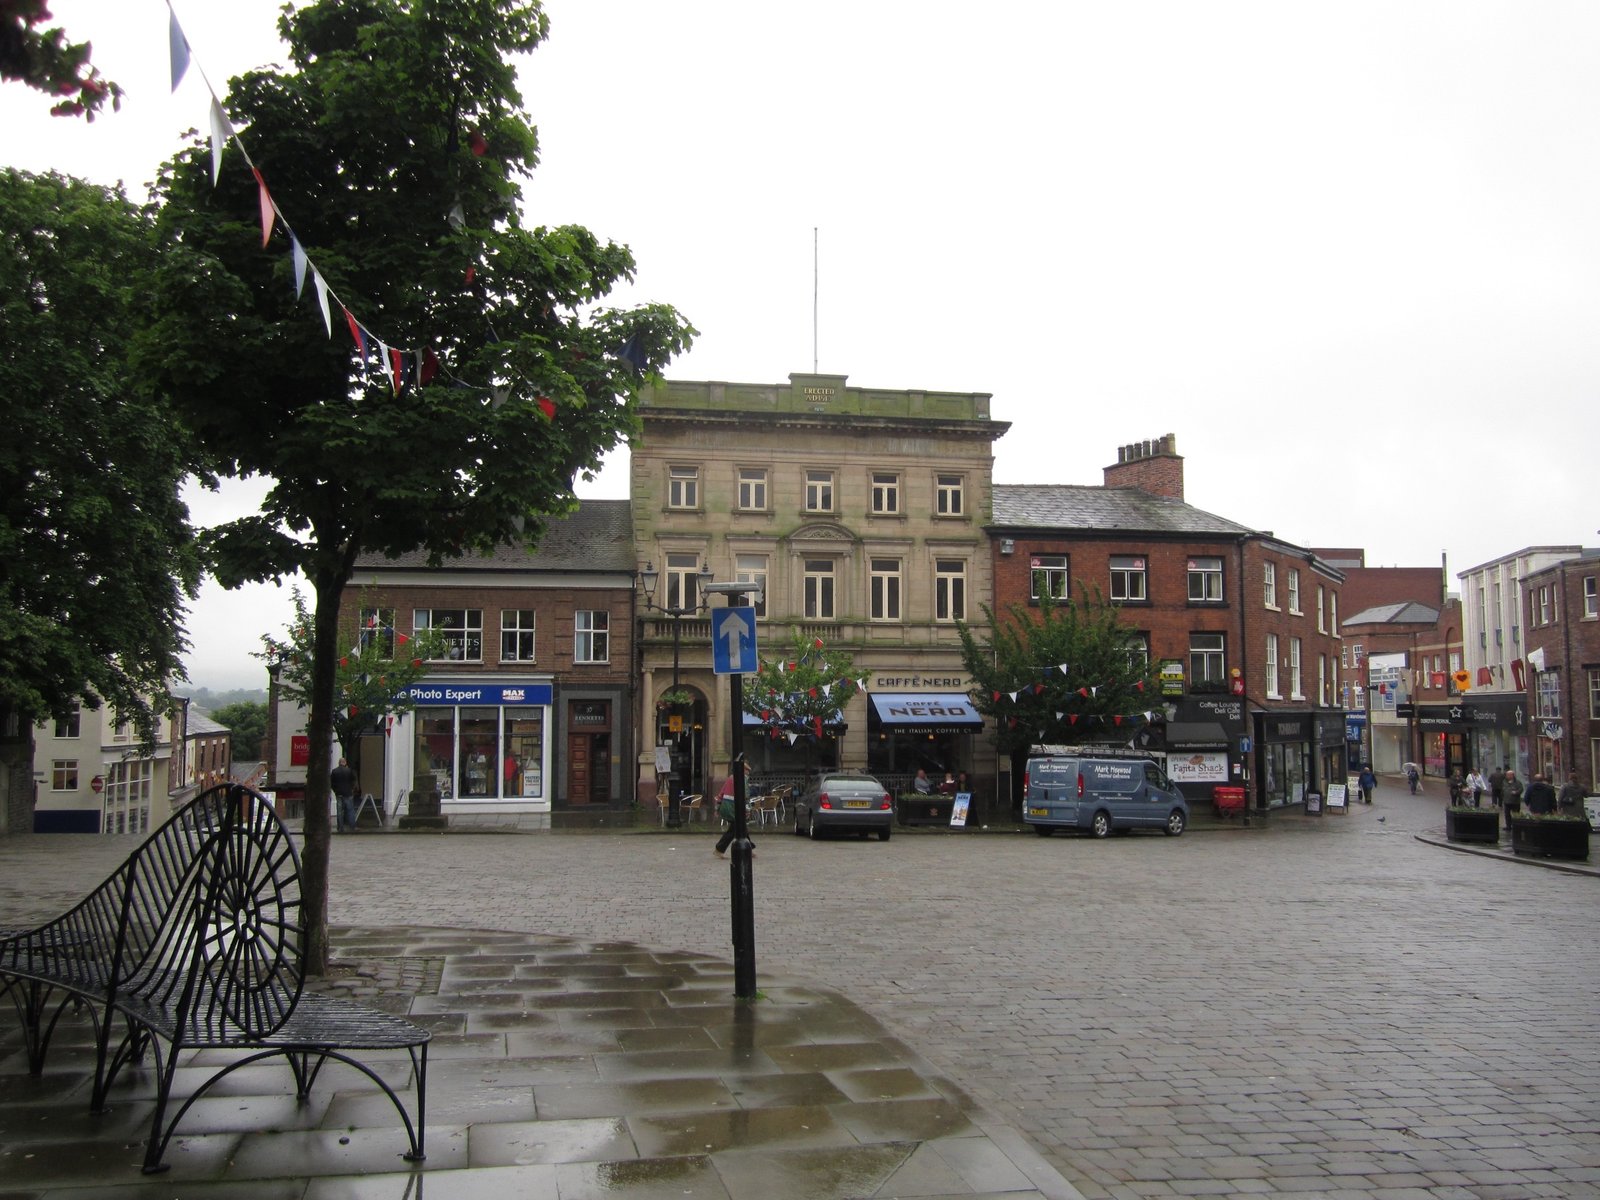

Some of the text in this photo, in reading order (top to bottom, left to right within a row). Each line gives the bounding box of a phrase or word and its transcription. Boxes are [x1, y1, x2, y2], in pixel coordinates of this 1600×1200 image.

[923, 678, 961, 687] NERO
[410, 688, 442, 699] Photo
[445, 688, 482, 702] Expert
[502, 689, 524, 697] MAX
[888, 707, 967, 716] NERO
[1094, 765, 1109, 774] Mark
[1173, 764, 1196, 774] Fajita
[1198, 763, 1224, 772] Shack
